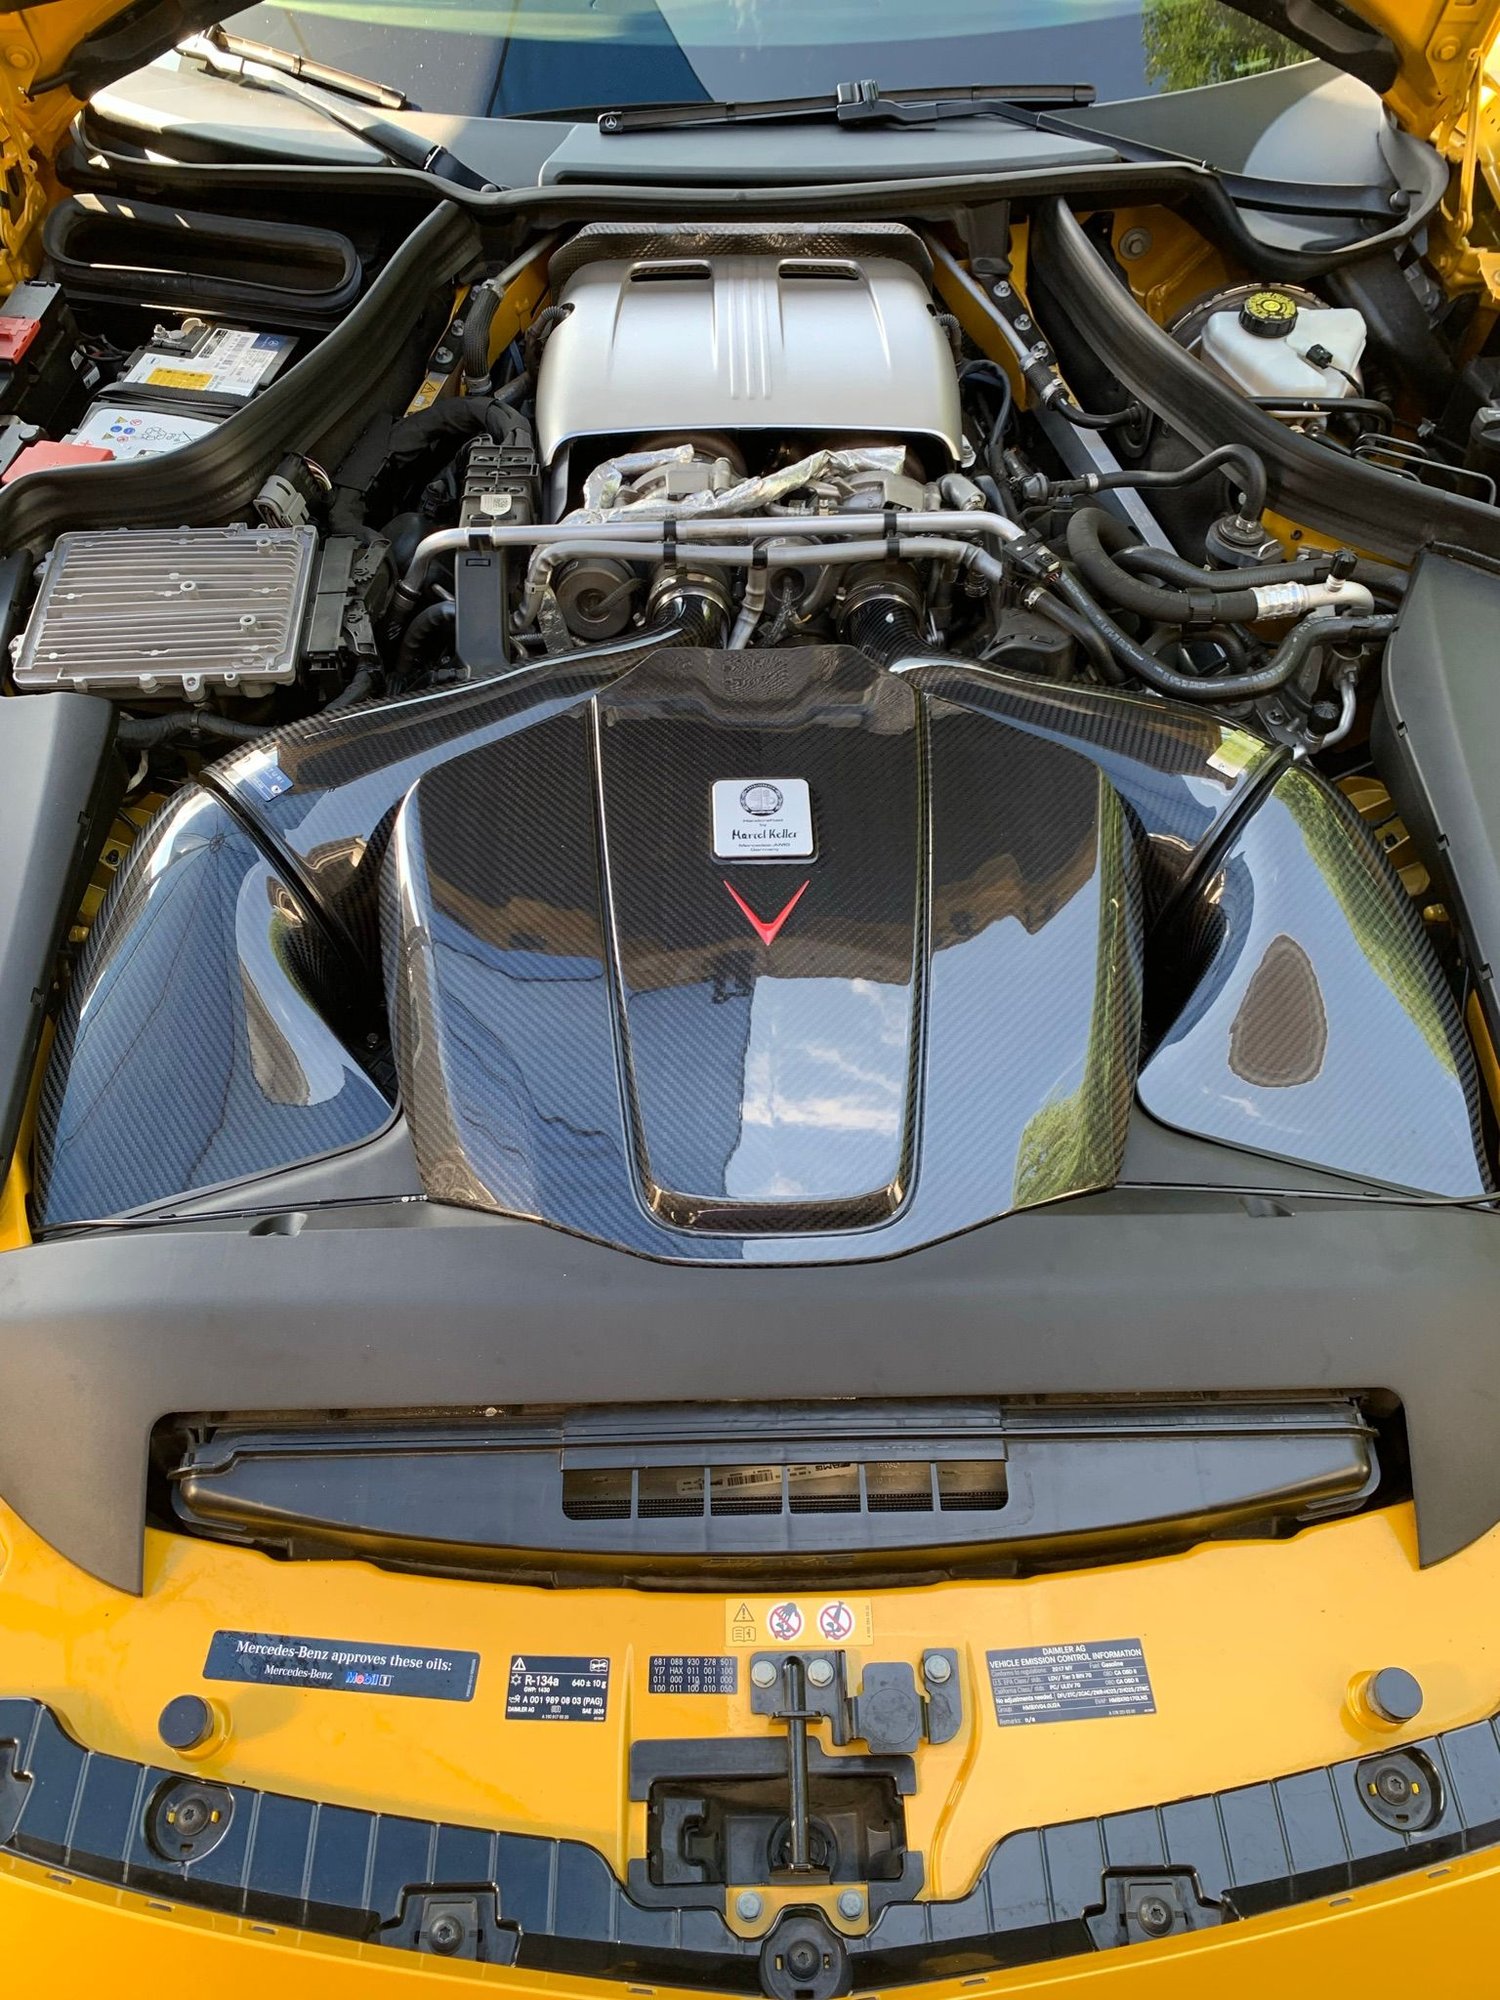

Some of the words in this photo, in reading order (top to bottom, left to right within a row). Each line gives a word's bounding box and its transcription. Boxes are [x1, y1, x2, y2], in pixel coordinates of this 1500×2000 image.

[732, 829, 766, 840] Marcel
[769, 829, 797, 839] Keller
[236, 1640, 329, 1660] Mercedes-Benz
[331, 1651, 387, 1665] approves
[390, 1654, 423, 1669] these
[426, 1658, 453, 1671] oils:
[1042, 1646, 1074, 1656] DAIMLER
[1075, 1644, 1086, 1653] AG
[653, 1658, 666, 1666] 681
[703, 1658, 716, 1666] 278
[989, 1659, 1020, 1669] VEHICLE
[1021, 1656, 1056, 1666] EMISSION
[1056, 1653, 1091, 1663] CONTROL
[1092, 1649, 1142, 1659] INFORMATION
[264, 1664, 334, 1680] Mercedes-Benz
[345, 1671, 379, 1686] Mobil
[703, 1667, 716, 1675] 001
[524, 1674, 559, 1687] R-134a
[572, 1679, 585, 1687] 640
[592, 1680, 601, 1688] 10
[654, 1684, 666, 1692] 100
[669, 1684, 682, 1692] 011
[703, 1684, 716, 1692] 010
[522, 1695, 528, 1704] A
[529, 1696, 543, 1704] 001
[560, 1697, 571, 1705] 08
[571, 1697, 582, 1705] 03
[583, 1696, 603, 1706] (PAG)
